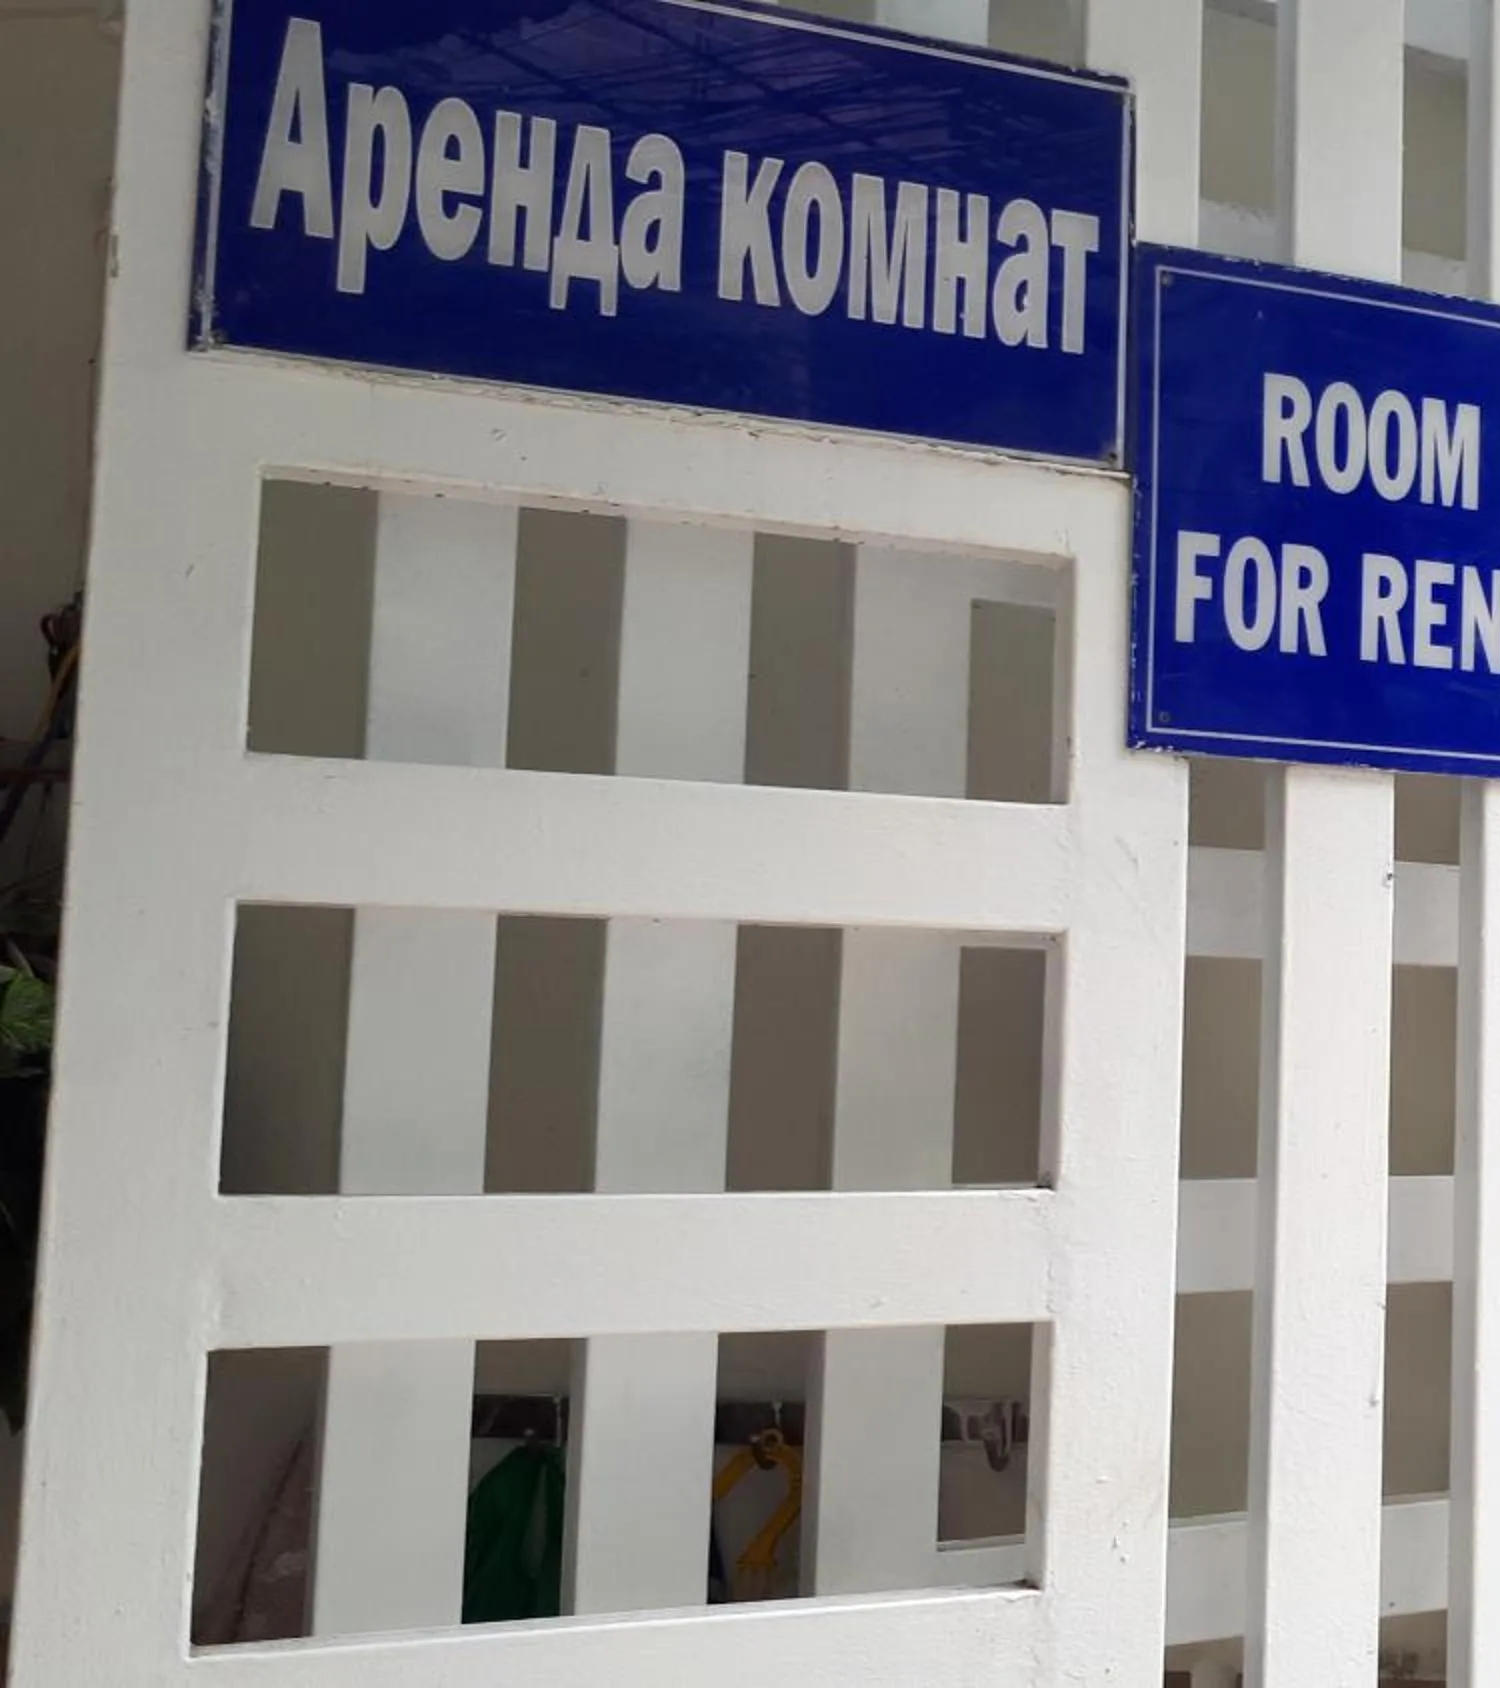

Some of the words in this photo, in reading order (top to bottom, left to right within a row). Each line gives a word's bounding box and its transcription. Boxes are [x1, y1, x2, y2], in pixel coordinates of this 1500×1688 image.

[250, 17, 685, 316] Аренда
[718, 150, 1099, 354] комнат
[1263, 373, 1480, 510] ROOM
[1175, 530, 1329, 656] FOR
